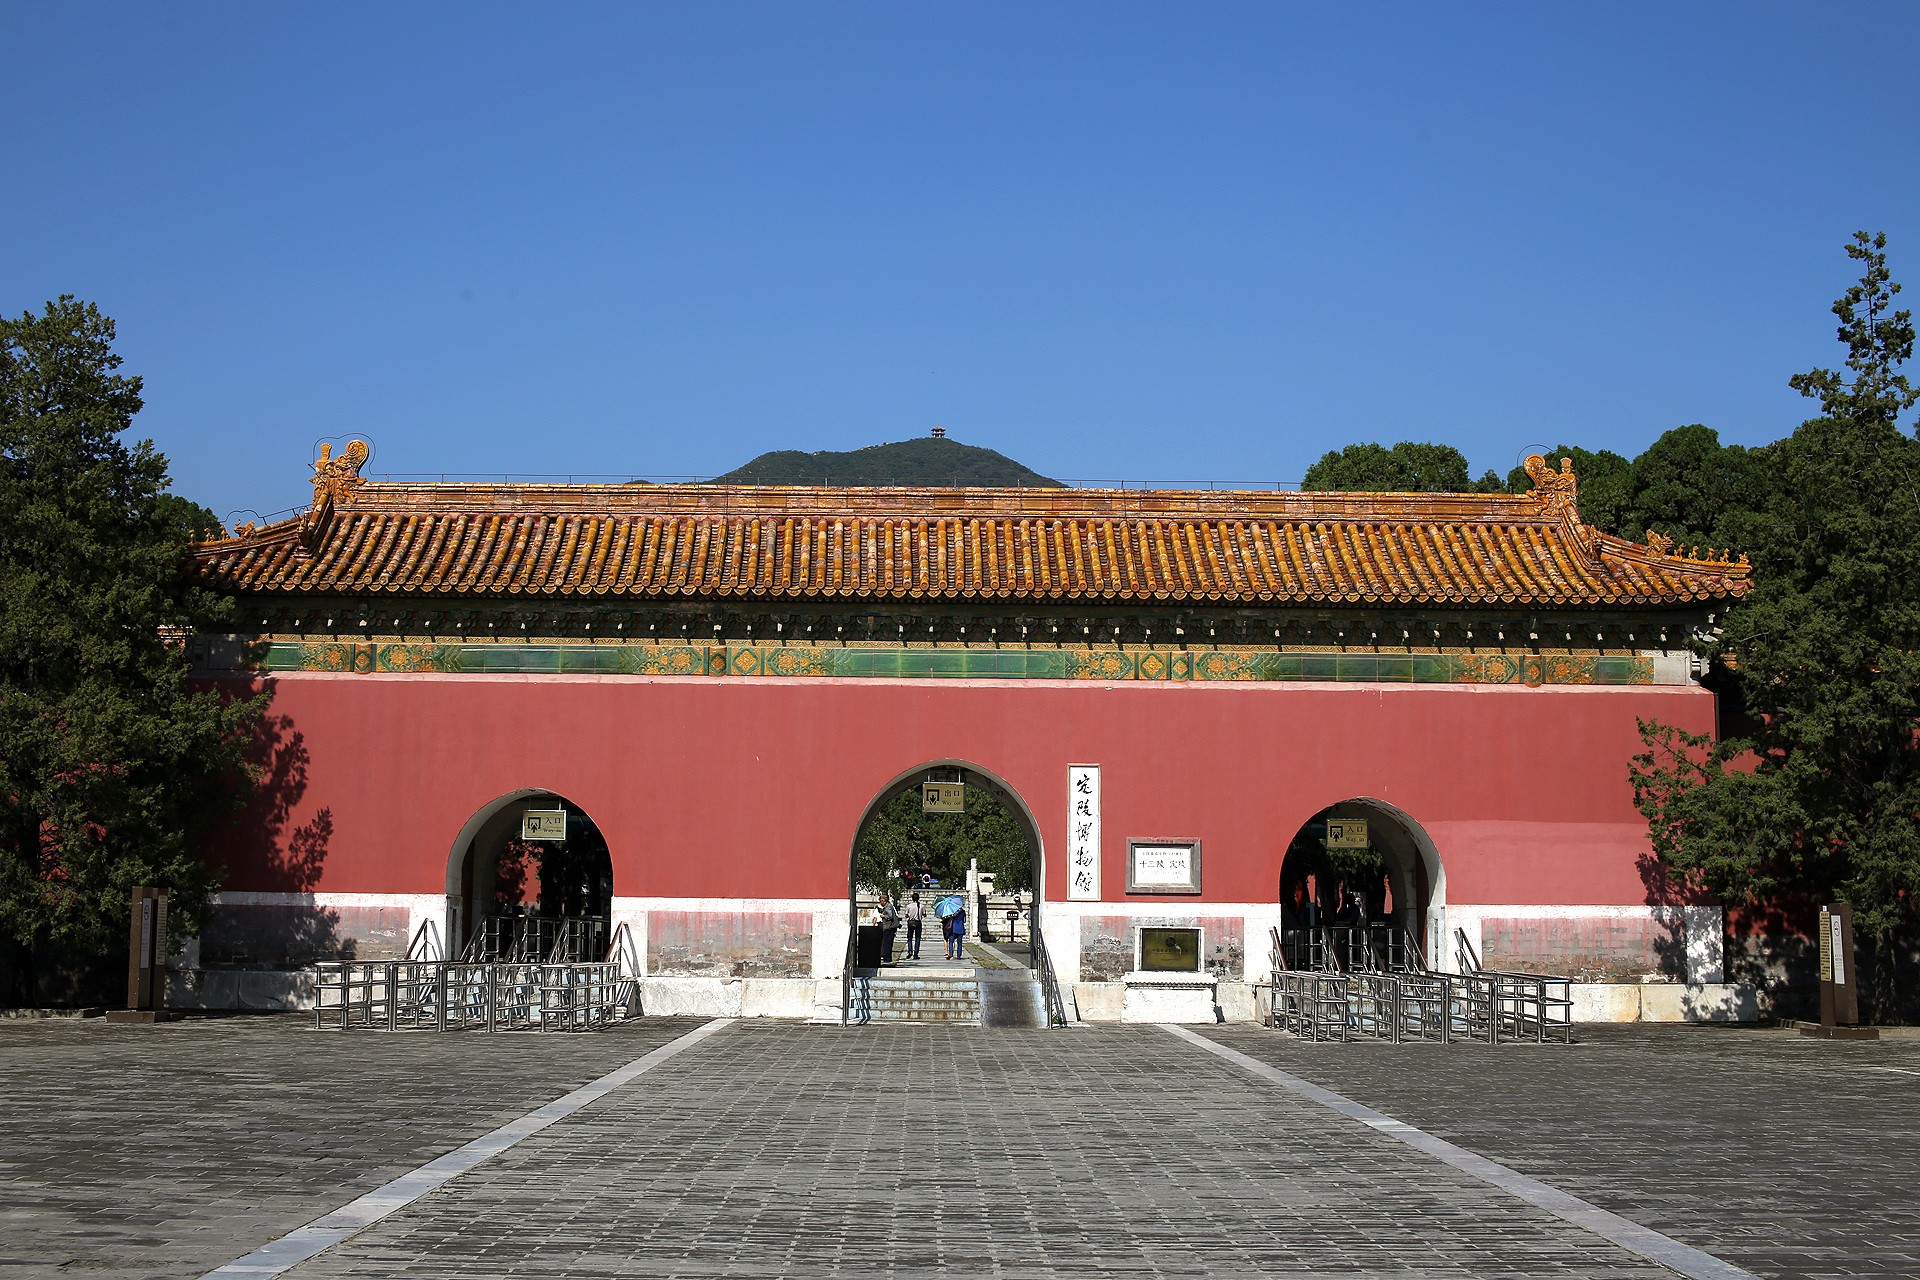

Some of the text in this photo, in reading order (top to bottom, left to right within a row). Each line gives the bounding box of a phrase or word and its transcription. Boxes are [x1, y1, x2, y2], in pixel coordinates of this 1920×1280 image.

[545, 817, 561, 825] 入口
[1139, 860, 1165, 869] 十三陵
